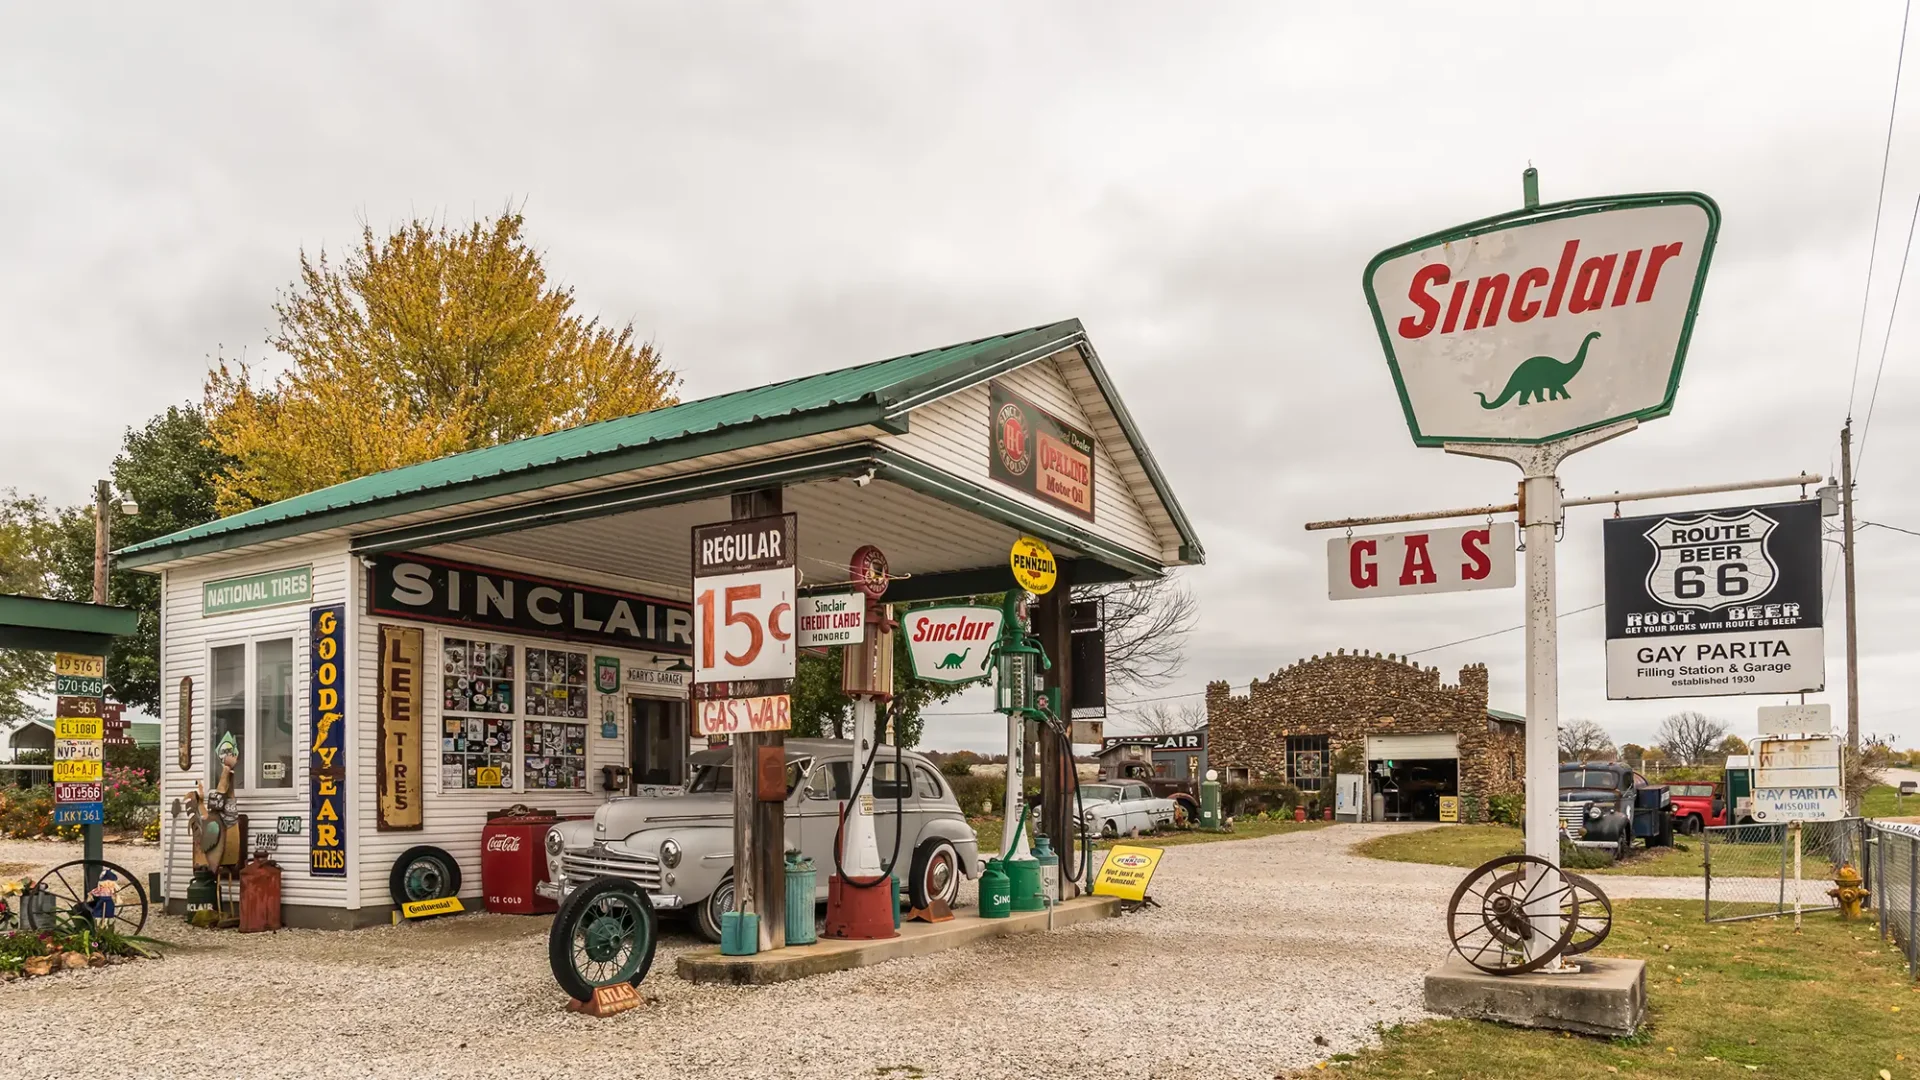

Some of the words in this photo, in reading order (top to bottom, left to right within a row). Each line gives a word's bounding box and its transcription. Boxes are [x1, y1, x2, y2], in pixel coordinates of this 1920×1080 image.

[1398, 239, 1683, 339] Sinclair
[1071, 432, 1091, 453] Dealer
[1040, 439, 1089, 487] OPALINE
[1046, 474, 1071, 497] Motor
[1072, 485, 1084, 504] Oil
[1672, 524, 1750, 544] ROUTE
[702, 529, 781, 565] REGULAR
[1680, 545, 1742, 563] BEER
[1013, 553, 1056, 574] PENNZOIL
[1350, 529, 1492, 589] GAS
[1674, 562, 1749, 599] 66
[207, 581, 268, 608] NATIONAL
[271, 574, 308, 598] TIRES
[391, 562, 693, 645] SINCLAIR
[815, 599, 847, 613] Sinclair
[801, 614, 832, 631] CREDIT
[833, 611, 861, 629] CARDS
[1626, 609, 1695, 627] ROOT
[1728, 602, 1800, 621] BEER
[912, 615, 995, 643] Sinclair
[1644, 624, 1667, 633] YOUR
[1669, 623, 1696, 632] KICKS
[1700, 622, 1723, 630] WITH
[1725, 620, 1755, 629] ROUTE
[1758, 619, 1770, 627] 66
[812, 631, 850, 642] HONORED
[1637, 645, 1687, 664] GAY
[1697, 640, 1791, 661] PARITA
[59, 658, 71, 670] 19
[73, 660, 93, 672] 576
[1637, 666, 1675, 679] Filling
[1679, 664, 1724, 676] Station
[1729, 663, 1739, 674] &
[1743, 661, 1792, 674] Garage
[57, 678, 101, 694] 670-646
[390, 638, 411, 721] LEE
[632, 669, 654, 682] GARY'S
[657, 672, 680, 685] GARAGE
[1671, 676, 1729, 687] established
[1732, 674, 1755, 684] 1930
[703, 699, 739, 733] GAS
[745, 696, 790, 731] WAR
[393, 732, 408, 810] TIRES
[1756, 788, 1785, 801] GAY
[58, 810, 100, 822] 1KKY361
[1775, 802, 1820, 811] MISSOURI
[312, 849, 345, 869] TIRES
[1118, 869, 1134, 877] just
[408, 901, 451, 913] Continental
[502, 896, 522, 904] COLD
[598, 984, 634, 1005] ATLAS
